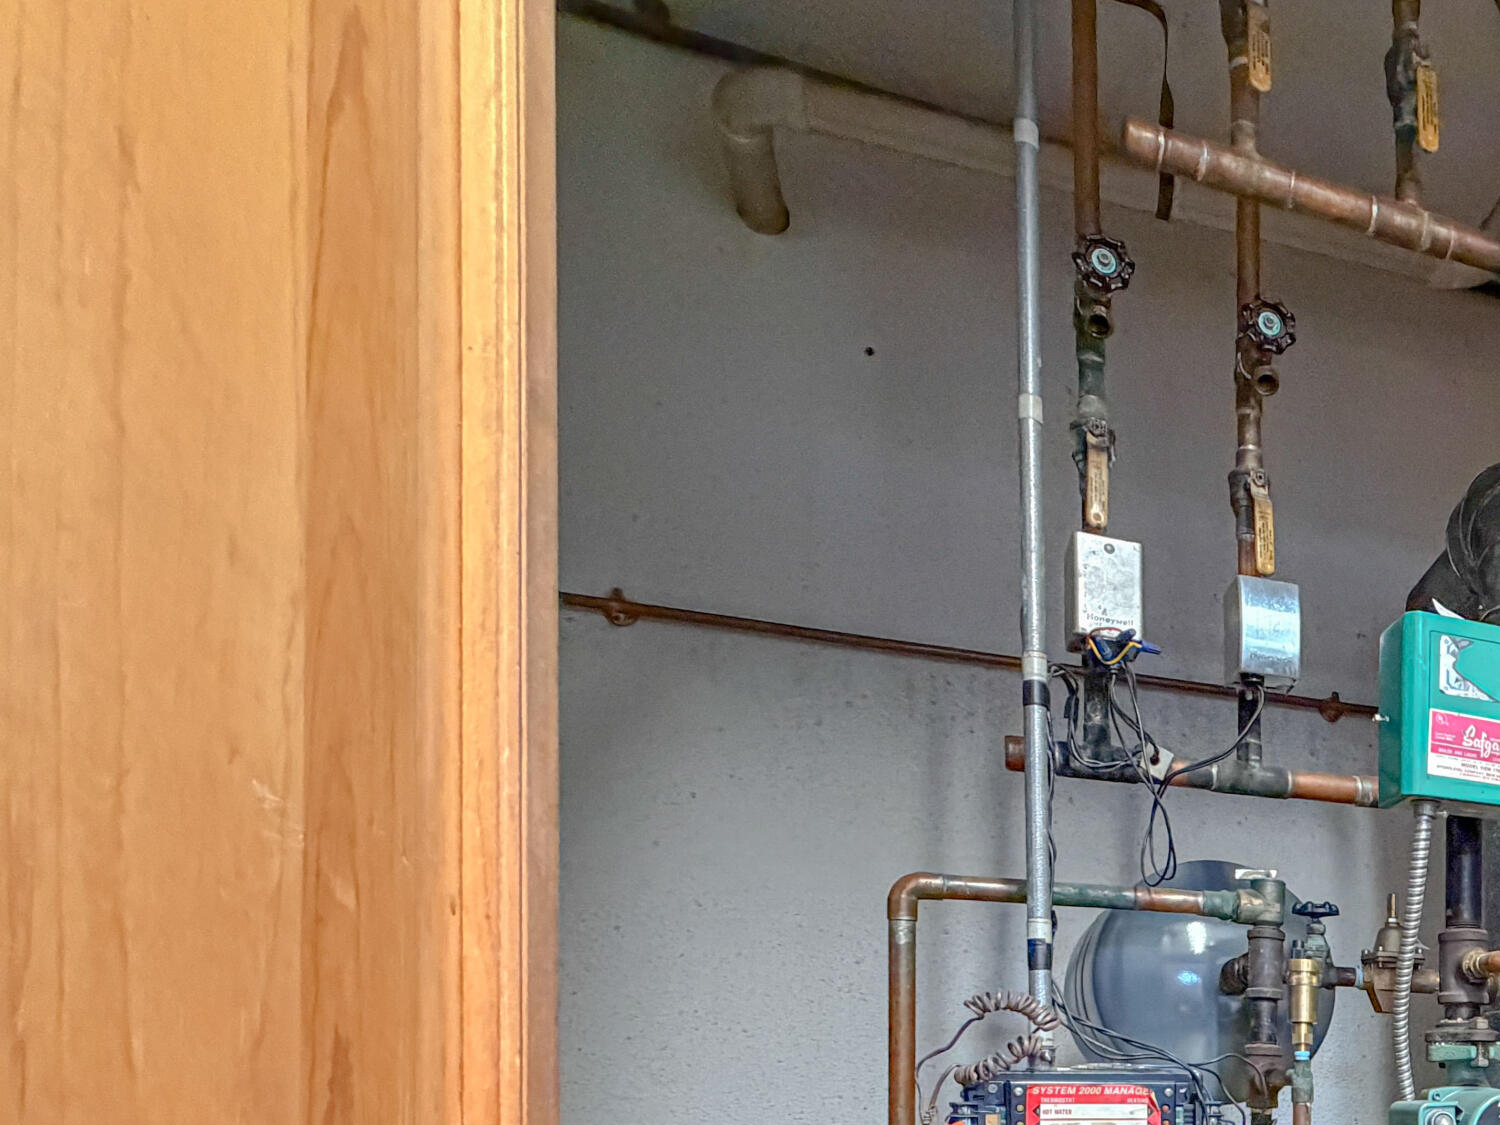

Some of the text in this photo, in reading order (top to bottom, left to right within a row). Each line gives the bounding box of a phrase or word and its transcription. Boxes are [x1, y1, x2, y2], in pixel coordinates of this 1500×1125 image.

[1086, 613, 1134, 626] Honeywell
[1032, 1086, 1076, 1095] SYSTEM
[1078, 1086, 1101, 1095] 2000
